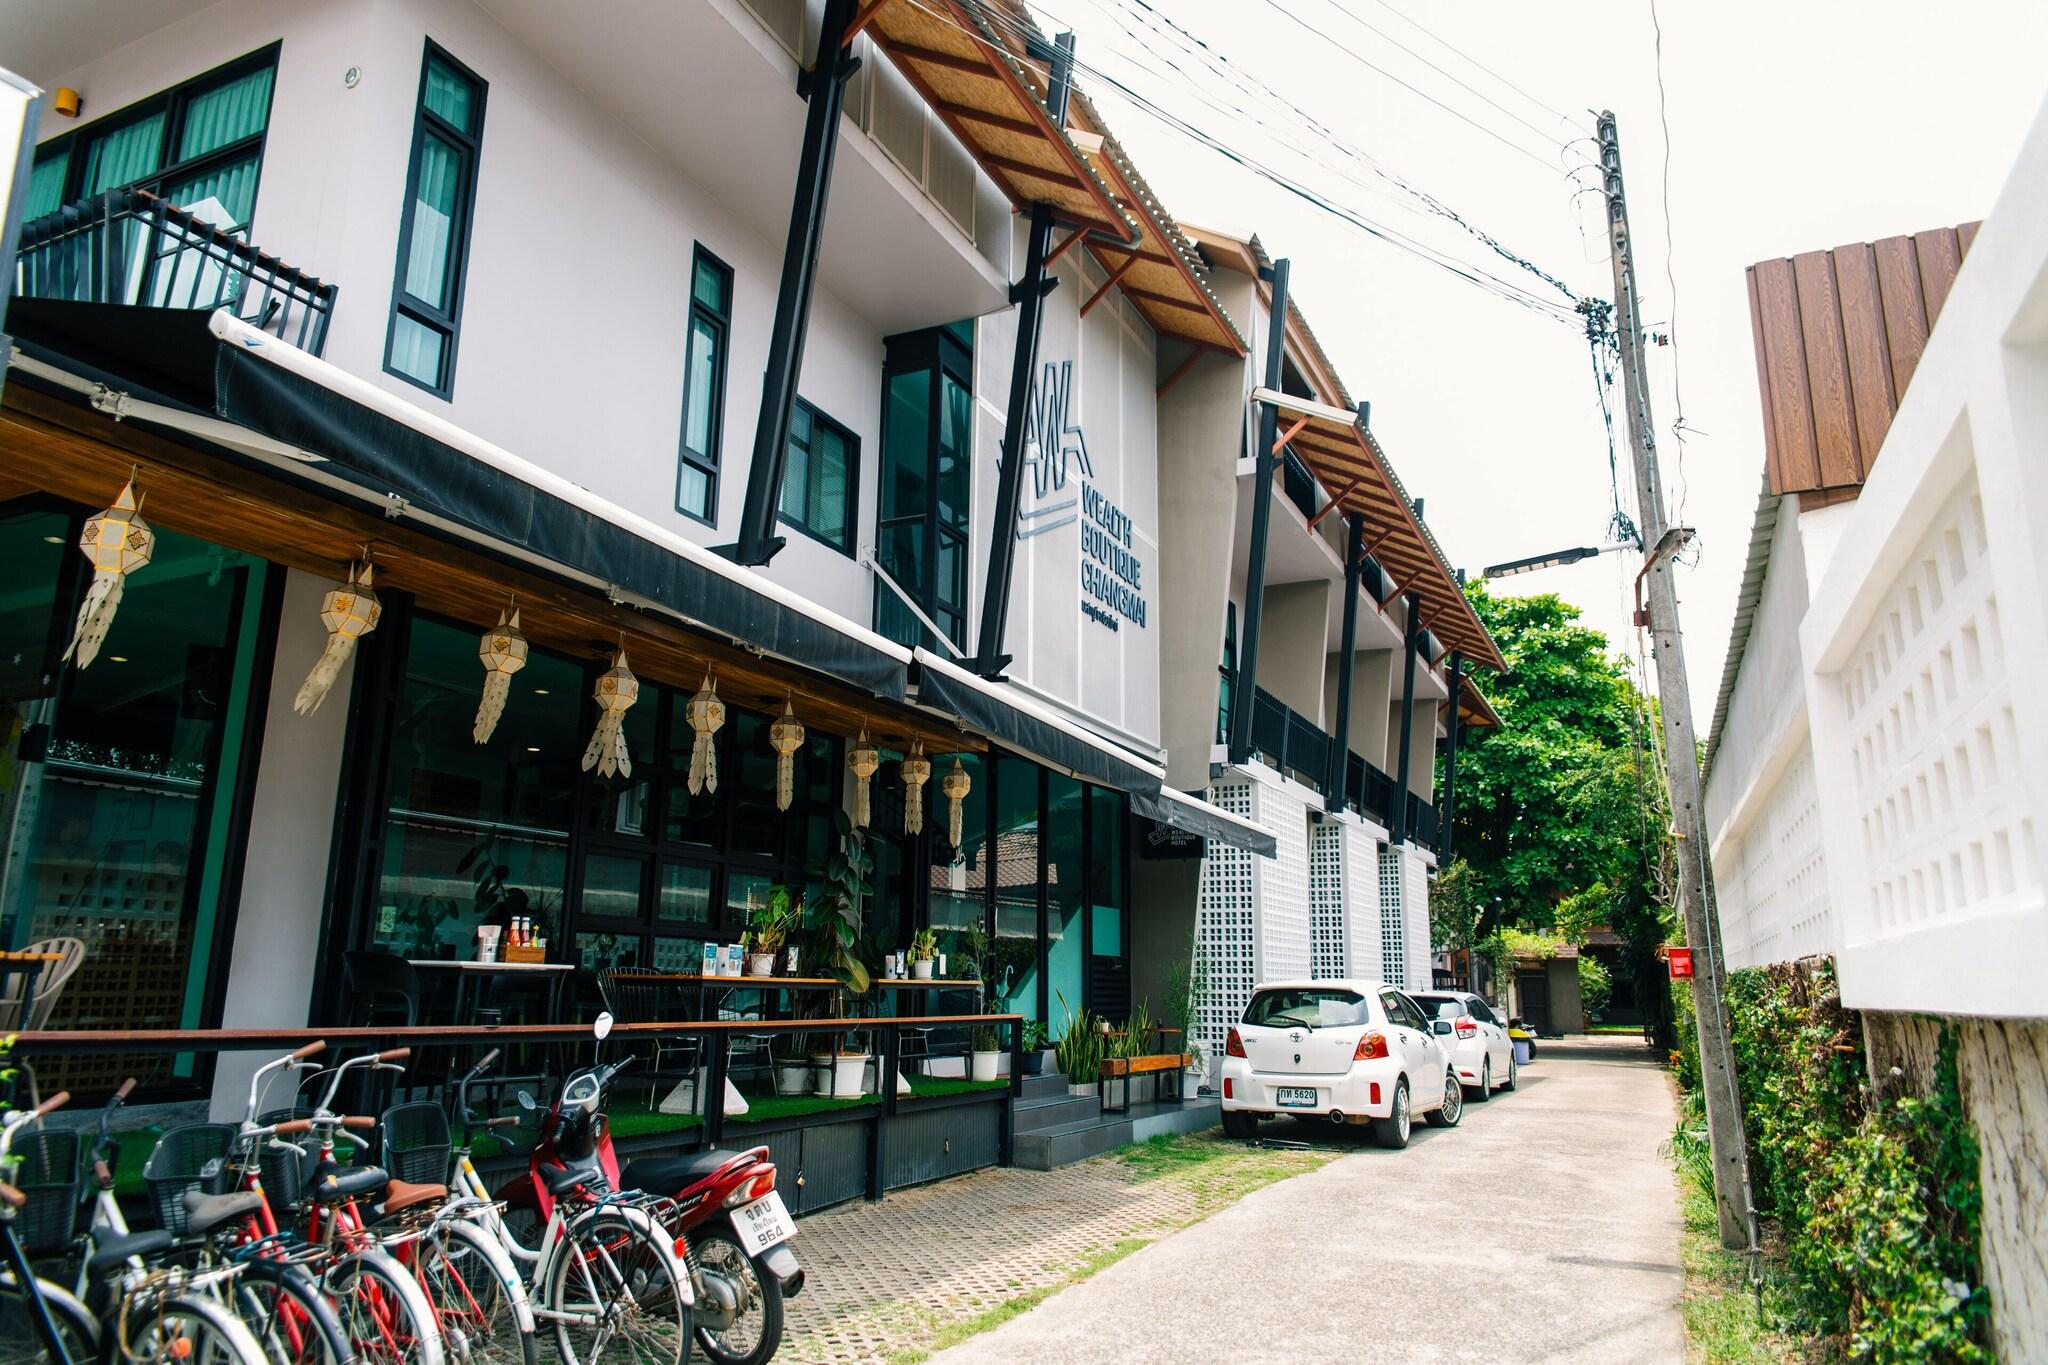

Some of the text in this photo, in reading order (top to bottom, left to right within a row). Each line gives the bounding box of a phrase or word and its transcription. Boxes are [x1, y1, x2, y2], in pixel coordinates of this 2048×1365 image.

[1082, 480, 1132, 548] WEALTH
[1082, 520, 1141, 590] BOUTIQUE
[1082, 559, 1146, 628] CHIANGMAI
[1294, 1090, 1314, 1098] 5620
[758, 1227, 784, 1246] 964
